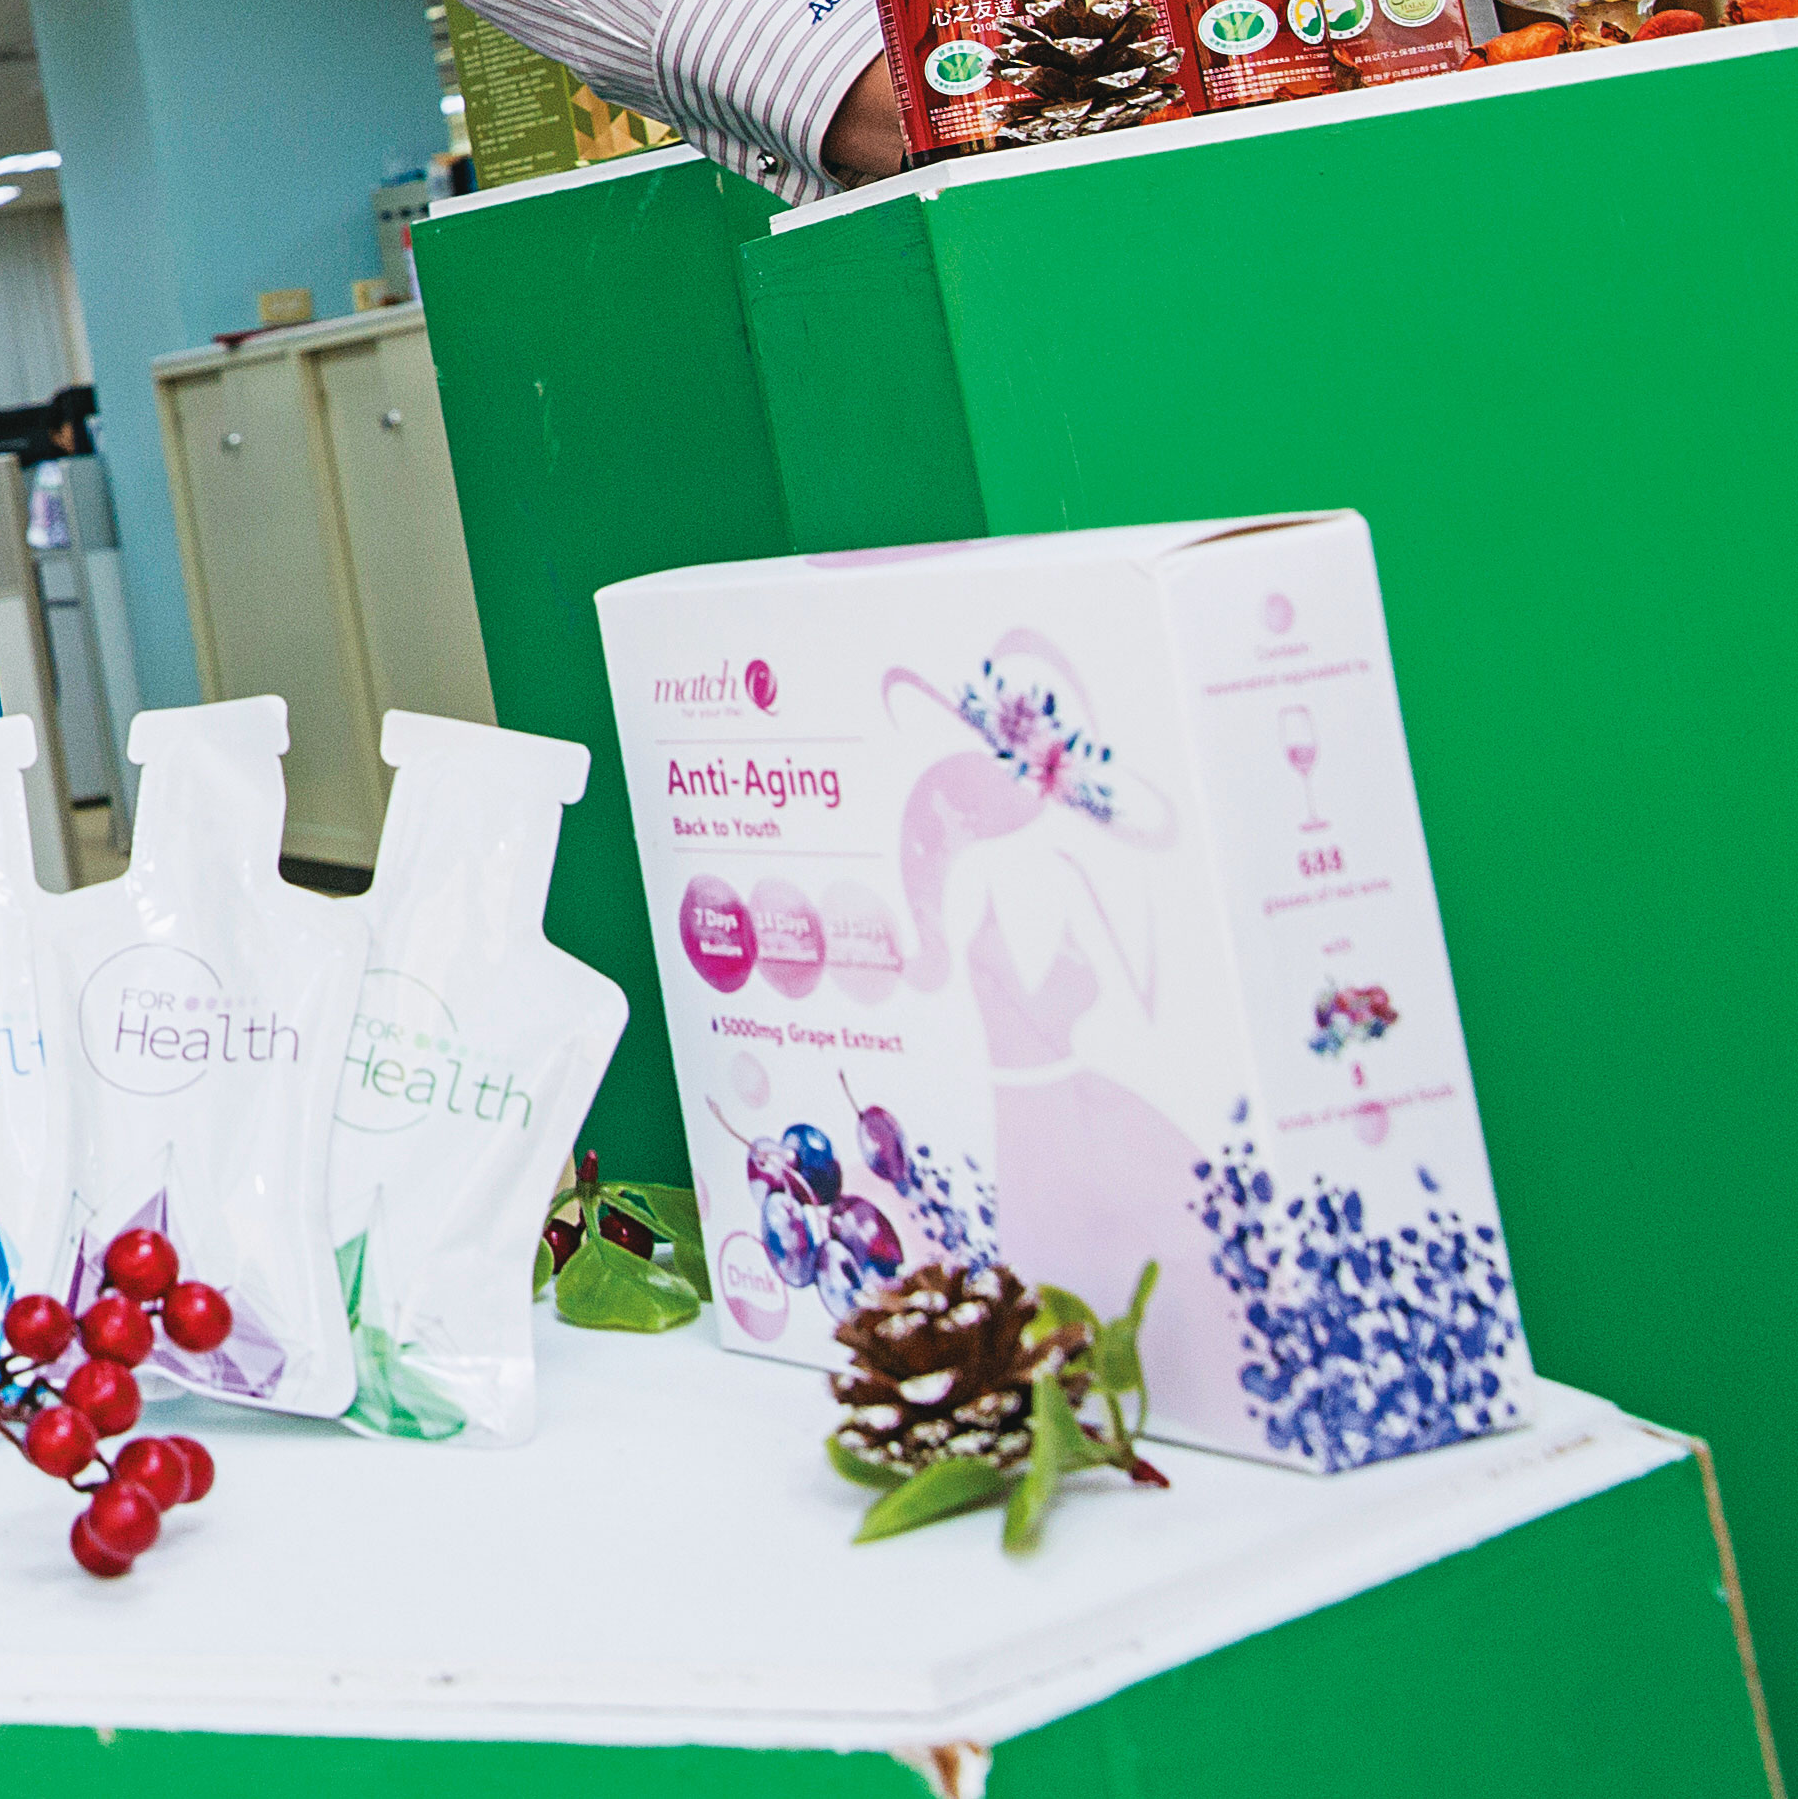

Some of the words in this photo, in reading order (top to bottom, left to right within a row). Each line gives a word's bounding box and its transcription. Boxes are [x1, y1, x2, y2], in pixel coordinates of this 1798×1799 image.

[654, 658, 738, 703] match
[668, 756, 841, 809] Anti-Aging
[672, 816, 708, 837] Back
[712, 817, 730, 837] to
[732, 817, 782, 838] Youth
[122, 987, 176, 1011] FOR
[114, 1011, 300, 1063] Health
[354, 1013, 403, 1042] FOR
[788, 1022, 837, 1048] Grape
[841, 1027, 904, 1054] Extract
